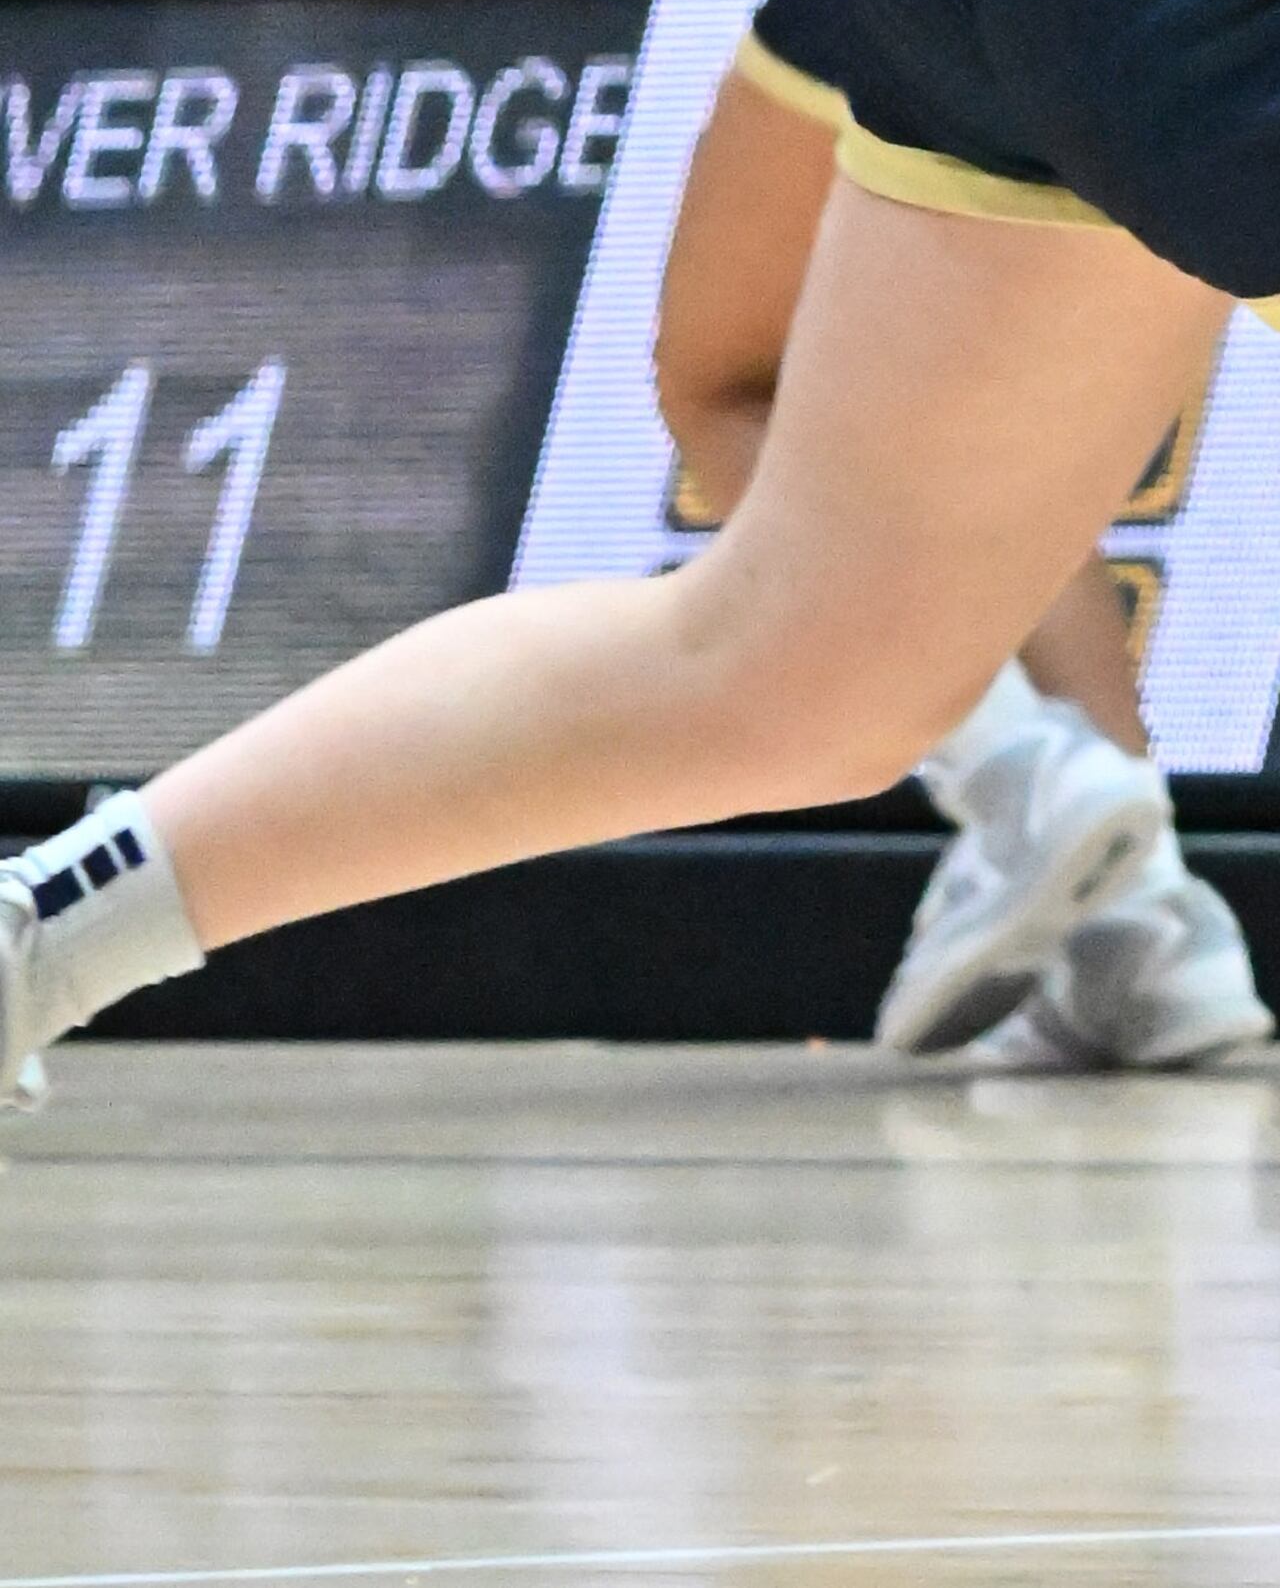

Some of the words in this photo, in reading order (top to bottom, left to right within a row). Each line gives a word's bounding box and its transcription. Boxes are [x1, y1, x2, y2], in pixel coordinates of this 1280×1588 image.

[0, 68, 240, 209] VER
[254, 58, 640, 206] RIDGE
[50, 356, 288, 654] 11
